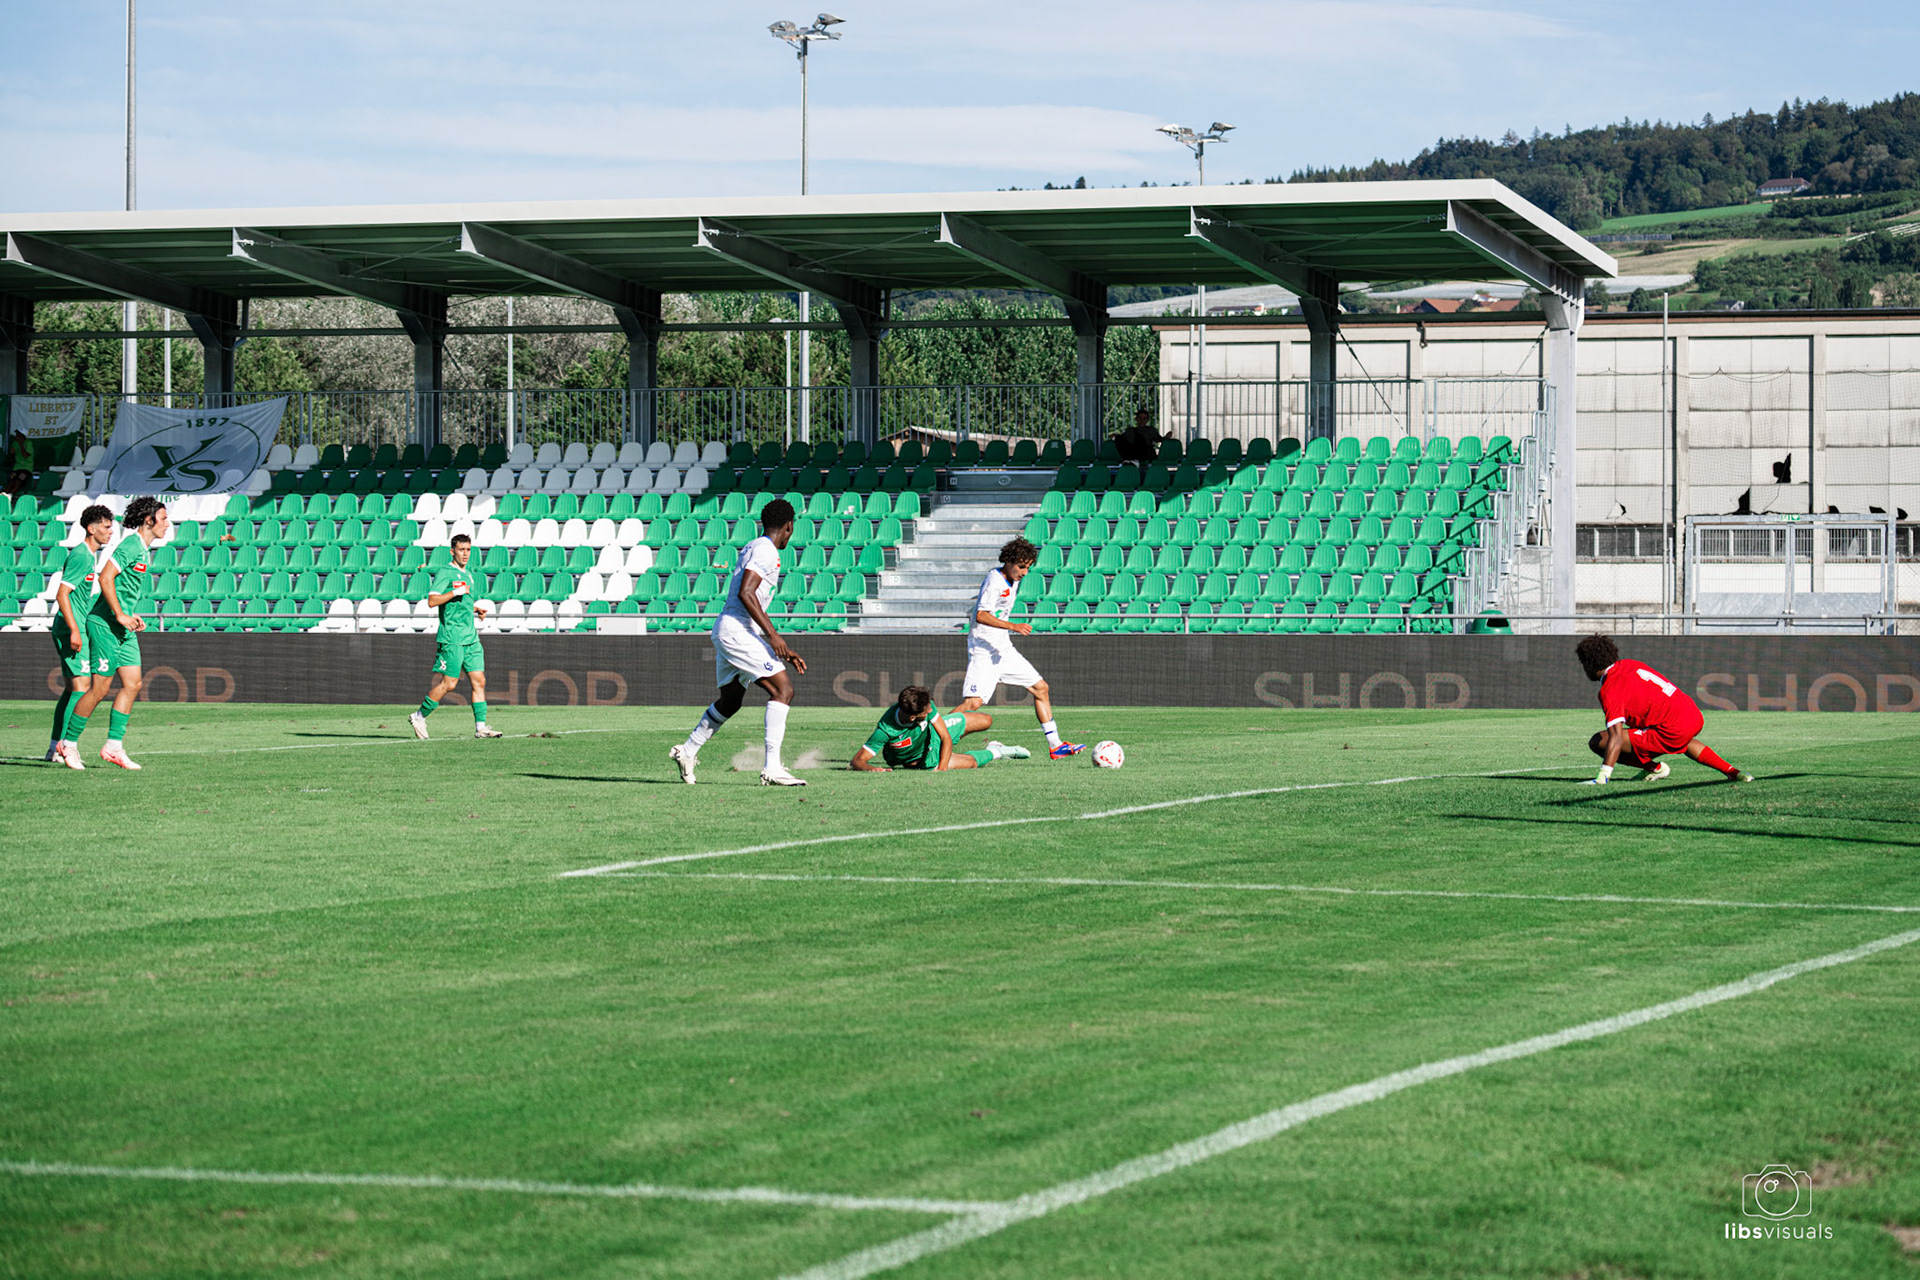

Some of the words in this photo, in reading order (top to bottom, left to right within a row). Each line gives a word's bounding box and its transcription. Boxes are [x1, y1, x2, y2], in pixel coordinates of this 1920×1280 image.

[44, 415, 59, 425] ET
[185, 416, 231, 429] 1897
[27, 426, 67, 437] PATRIE
[1254, 671, 1471, 709] SHOP
[1636, 668, 1677, 697] 1
[1696, 672, 1920, 711] SHOP
